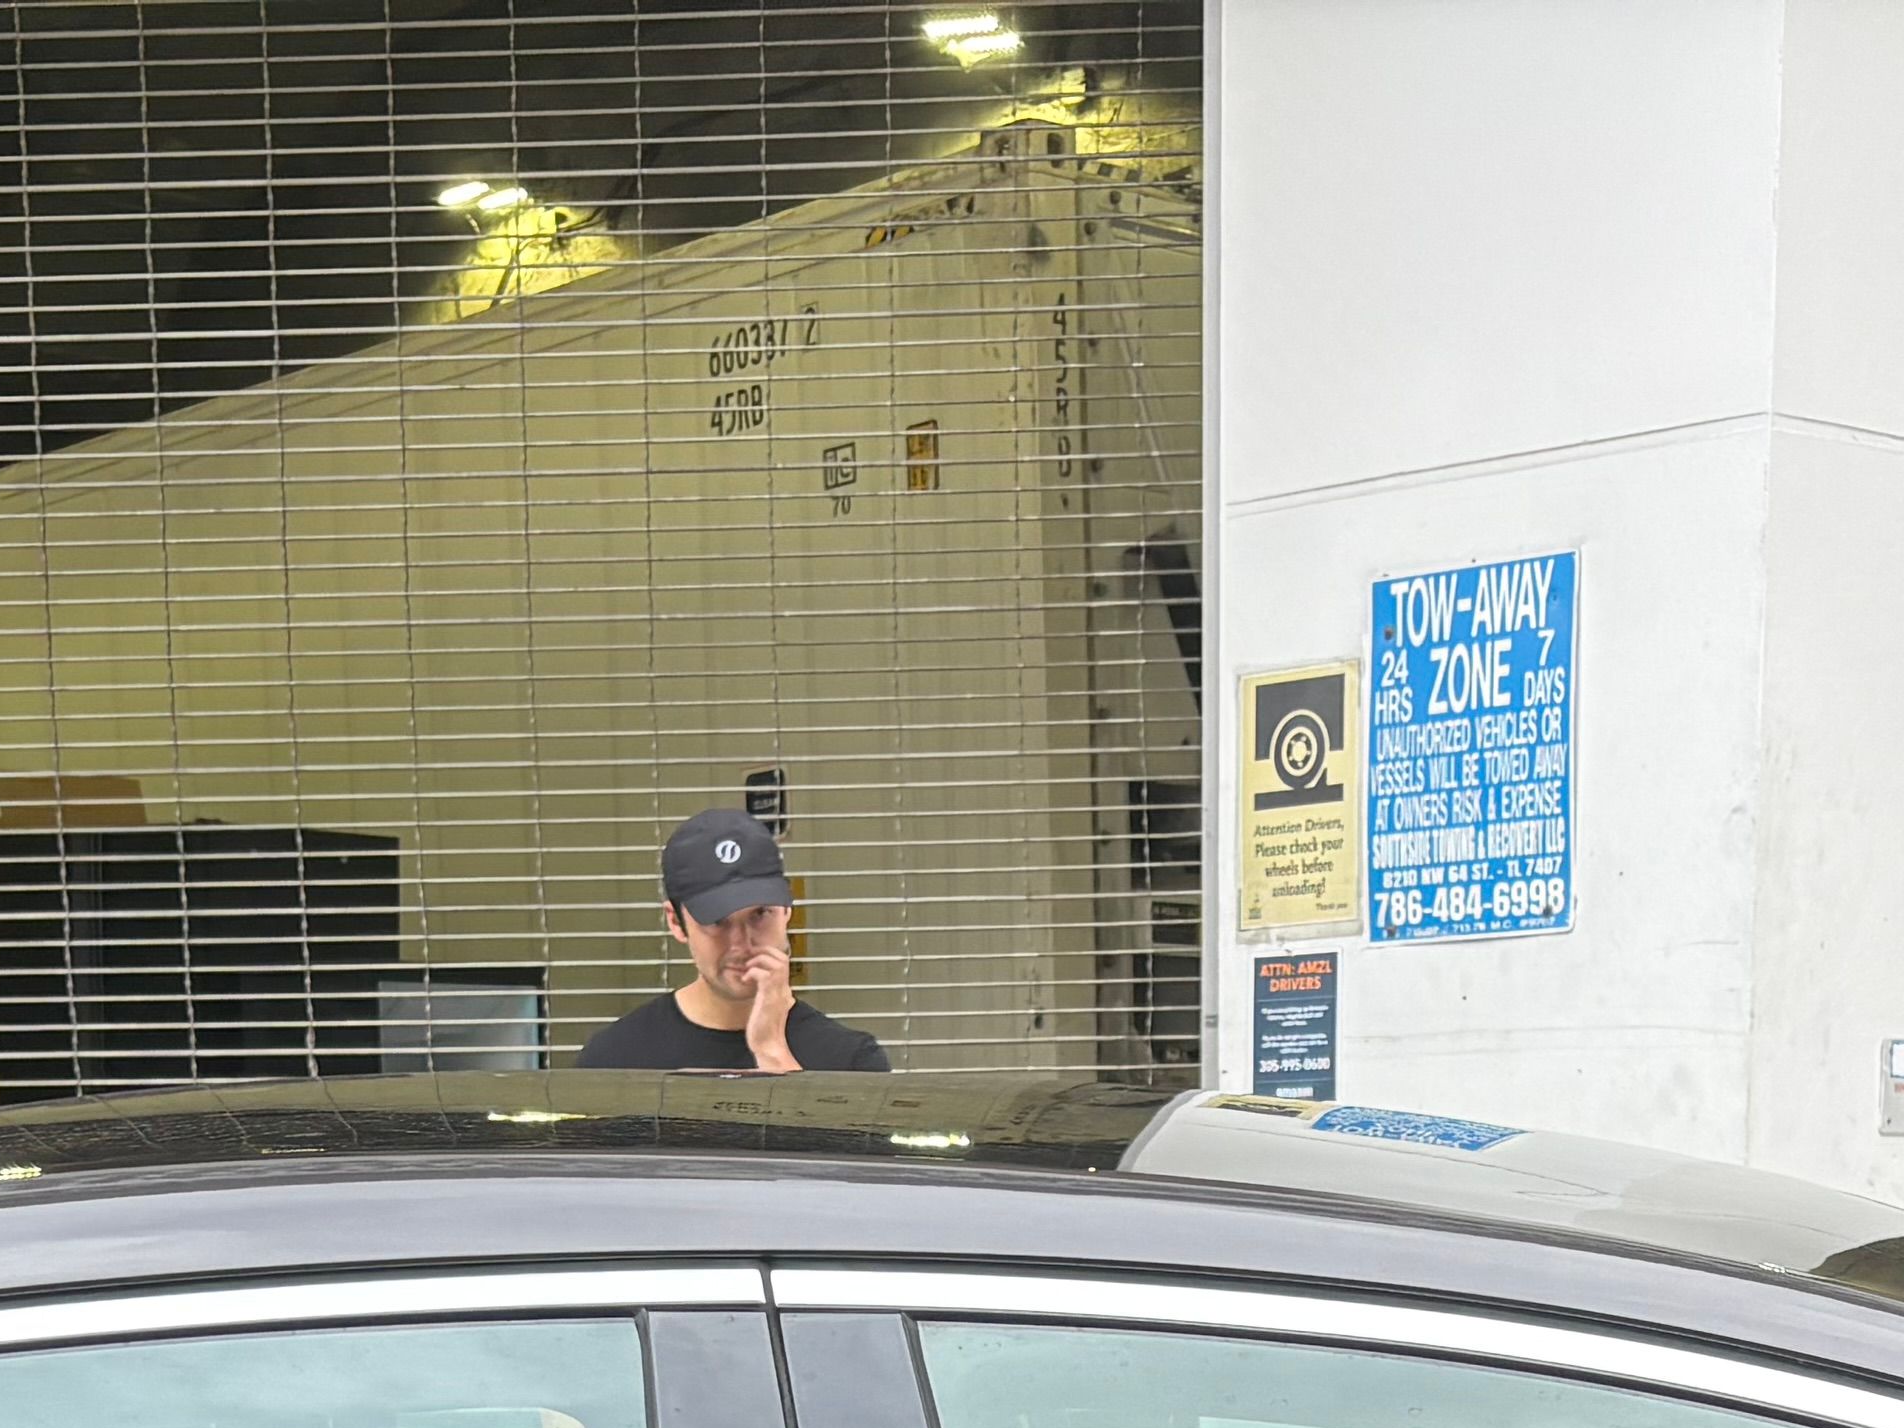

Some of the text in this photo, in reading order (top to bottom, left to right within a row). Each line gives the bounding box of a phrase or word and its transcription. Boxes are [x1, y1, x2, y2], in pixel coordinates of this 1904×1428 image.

[1391, 560, 1554, 648] TOW-AWAY
[1538, 629, 1555, 665] 7
[1381, 650, 1409, 687] 24
[1428, 639, 1512, 715] ZONE
[1524, 668, 1564, 707] DAYS
[1375, 688, 1413, 725] HRS
[1376, 708, 1561, 760] UNAUTHORIZED VEHICLES OR
[1371, 744, 1568, 796] VESSELS WILL BE TOWED AWAY
[1375, 799, 1390, 830] AT
[1394, 794, 1448, 829] OWNERS
[1452, 789, 1482, 824] RISK
[1502, 781, 1562, 818] EXPENSE
[1254, 818, 1344, 837] Attention Drivers,
[1545, 818, 1565, 853] LLC
[1255, 842, 1286, 857] Please
[1321, 838, 1344, 855] your
[1265, 857, 1334, 877] wheels before
[1421, 867, 1444, 884] NW
[1374, 878, 1565, 928] 786-484-6998
[1269, 976, 1322, 992] DRIVERS
